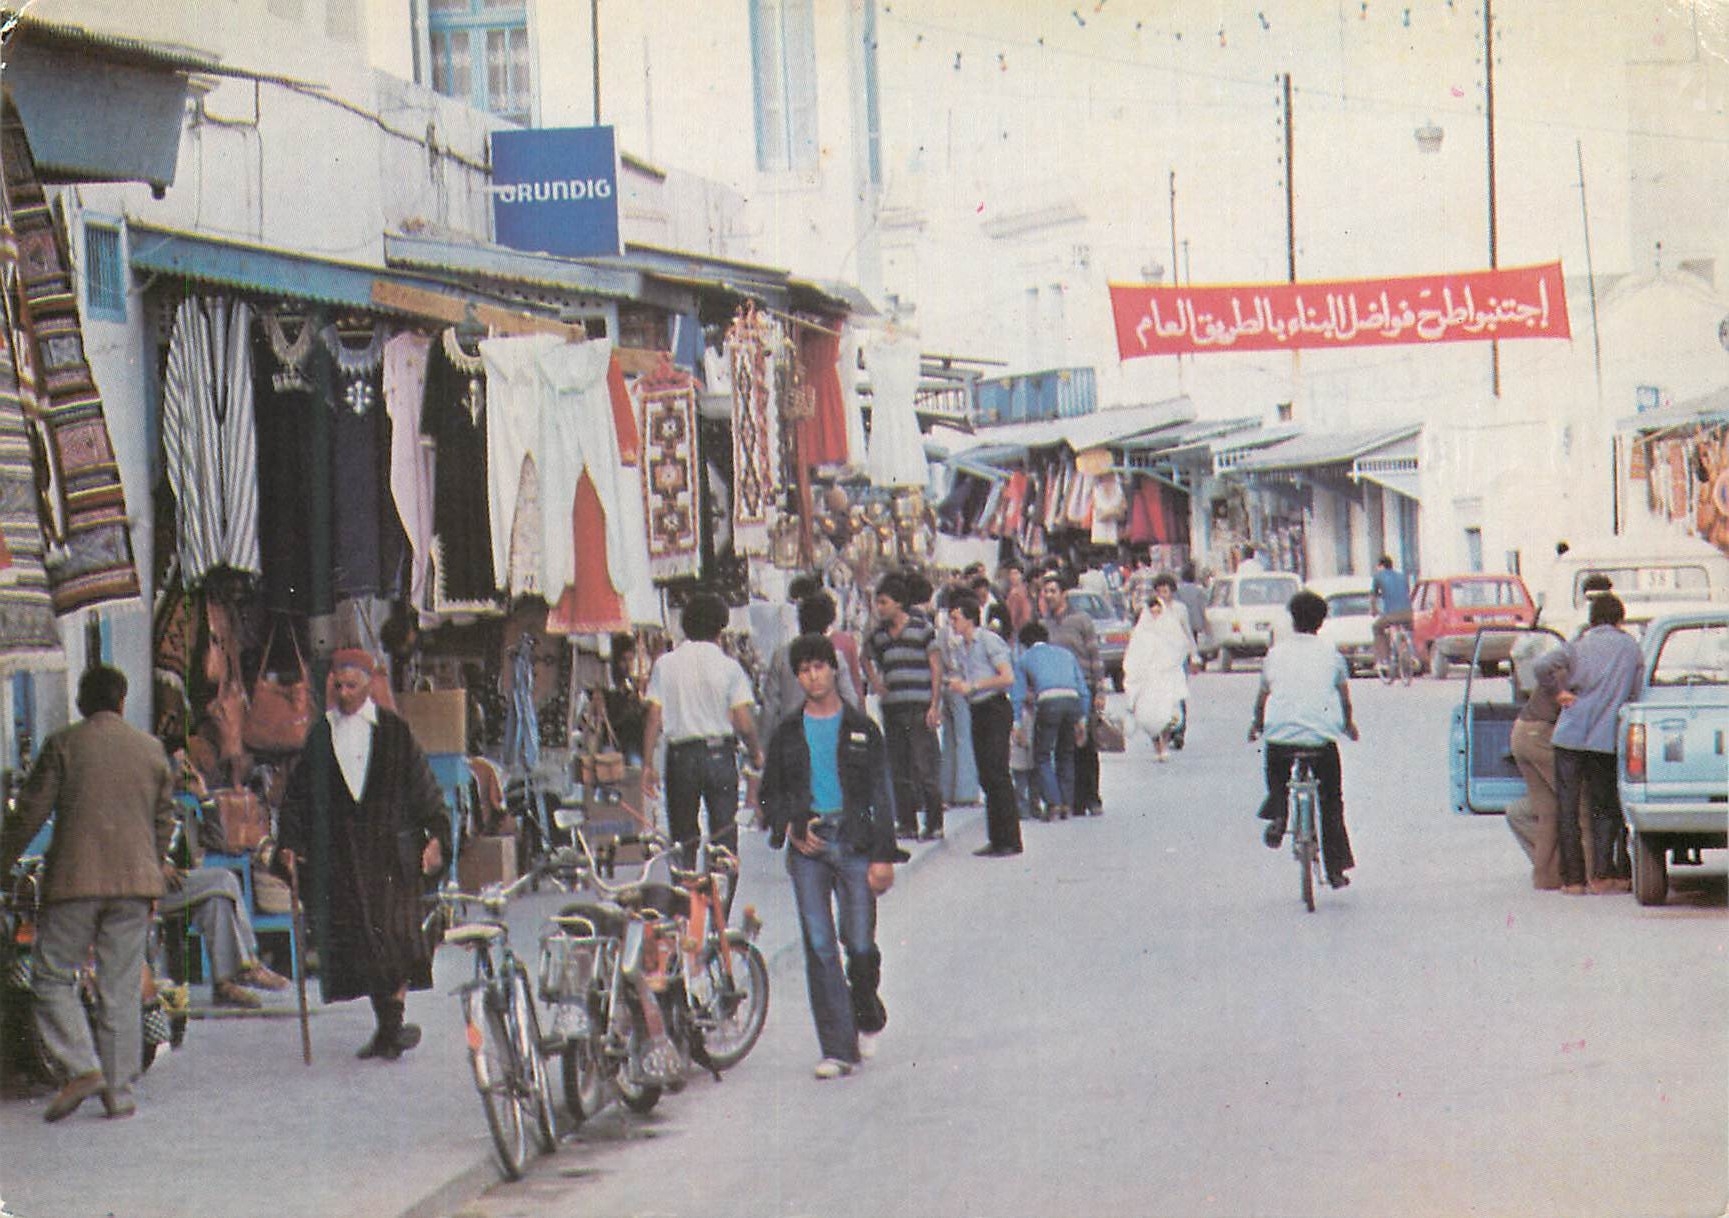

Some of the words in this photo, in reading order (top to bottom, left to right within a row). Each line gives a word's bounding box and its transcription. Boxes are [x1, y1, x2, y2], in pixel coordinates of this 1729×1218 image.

[1136, 297, 1195, 349] العام
[1193, 296, 1287, 346] بالطريق
[1335, 290, 1416, 341] فواضل
